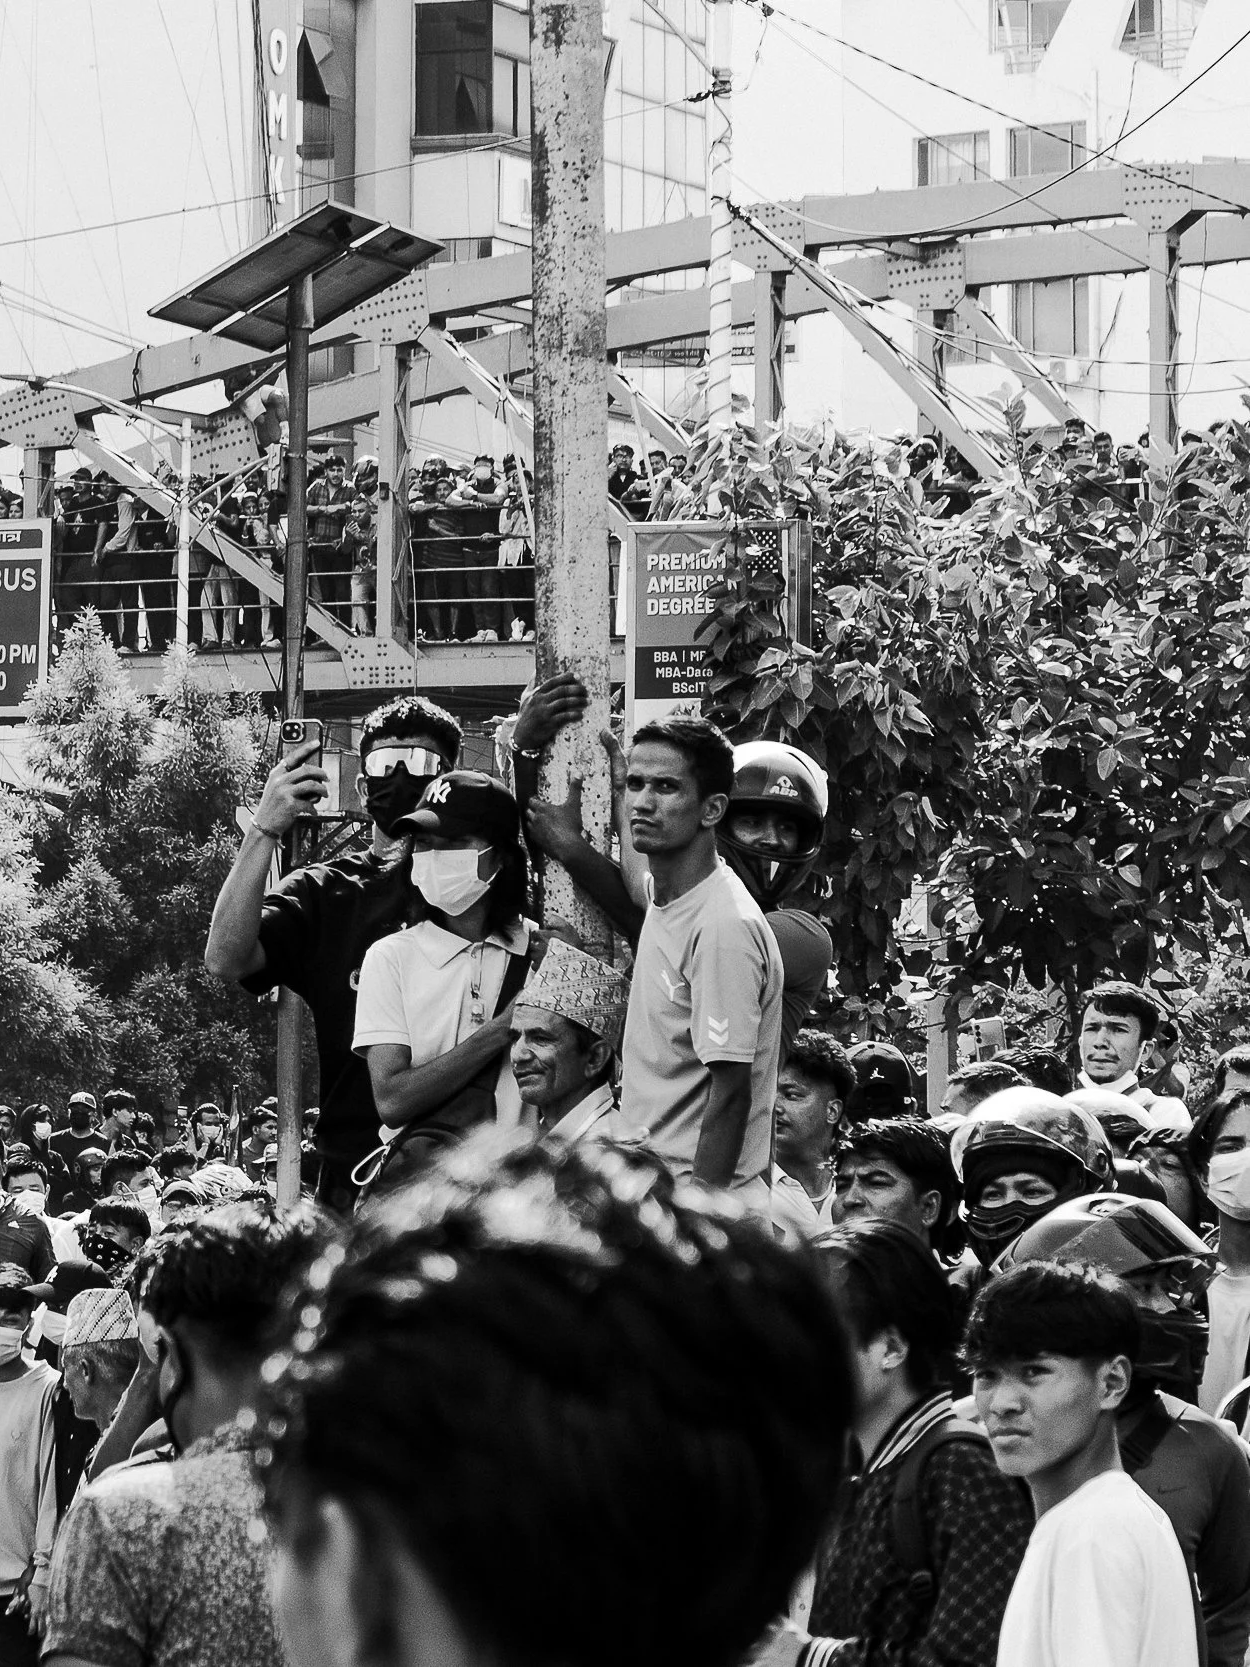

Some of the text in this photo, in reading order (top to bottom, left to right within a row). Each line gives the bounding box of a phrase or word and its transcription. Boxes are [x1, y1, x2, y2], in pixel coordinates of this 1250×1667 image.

[268, 28, 288, 231] OMK
[647, 553, 727, 572] PREMIUM
[647, 597, 716, 615] DEGREE
[9, 644, 37, 664] PM
[653, 651, 678, 663] BBA
[672, 681, 706, 694] BScIT
[426, 780, 451, 804] NY
